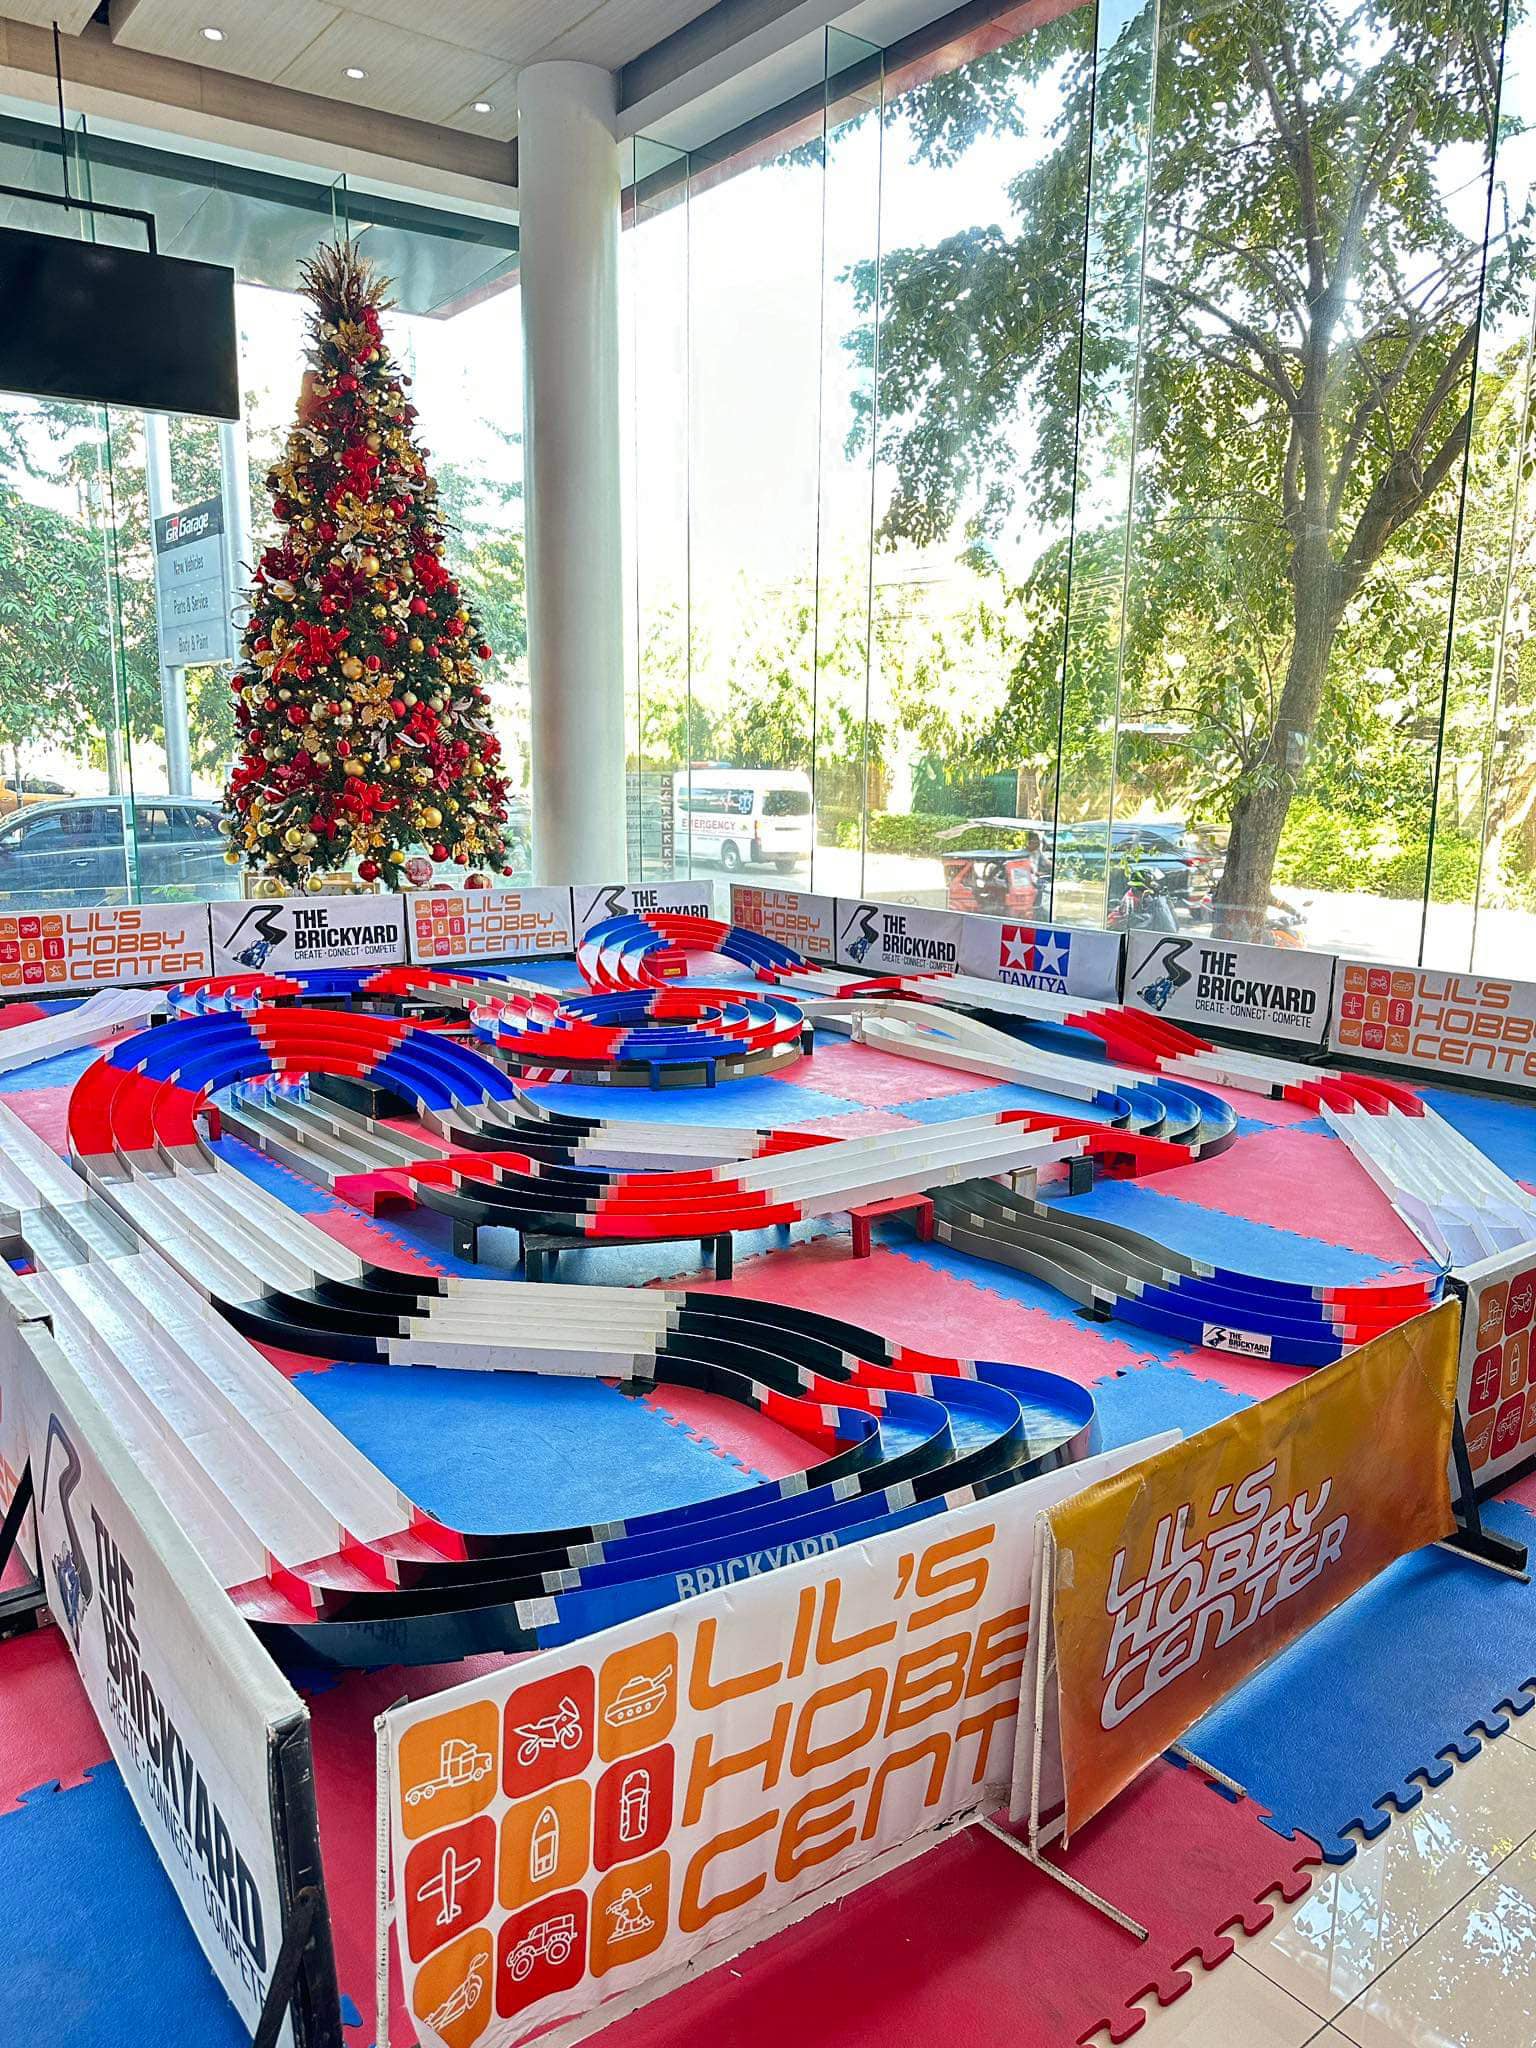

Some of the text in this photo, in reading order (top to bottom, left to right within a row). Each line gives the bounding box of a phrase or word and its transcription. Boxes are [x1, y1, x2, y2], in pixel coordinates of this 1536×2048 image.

[166, 513, 208, 541] GR Garage
[682, 818, 735, 830] EERGENCY
[466, 895, 521, 913] LIL'S
[632, 890, 658, 907] THE
[763, 891, 798, 911] LIL'S
[66, 910, 141, 933] LIL'S
[292, 909, 328, 929] THE
[468, 912, 553, 934] HOBBY
[764, 910, 820, 932] HOBBY
[883, 914, 906, 935] THE
[68, 930, 185, 957] HOBBY
[294, 925, 398, 949] BRICKYARD
[468, 931, 568, 953] CENTER
[883, 934, 956, 962] BRICKYARD
[294, 944, 397, 960] CREATE CONNECT COMPETE
[882, 953, 954, 972] CREATE CONNECT COMPETE
[1200, 950, 1237, 977] THE
[70, 952, 204, 980] CENTER
[999, 970, 1068, 995] TAMIYA
[1197, 974, 1316, 1014] BRICKYARD
[1418, 975, 1512, 1009] LIL'S
[1195, 1000, 1312, 1028] CREATE CONNECT COMPETE
[1414, 1004, 1536, 1043] HOBB
[1229, 1332, 1243, 1340] THE
[1229, 1340, 1269, 1353] BRICKYARD
[1105, 1457, 1278, 1616] LIL'S
[91, 1504, 140, 1656] THE
[675, 1533, 839, 1601] BRICKYARD
[1103, 1477, 1332, 1680] HOBBY
[688, 1523, 996, 1710] LIL'S
[1100, 1513, 1349, 1731] CENTER
[100, 1592, 267, 1973] BRICKYARD
[107, 1677, 141, 1772] CREATE
[147, 1760, 195, 1881] CONNECT
